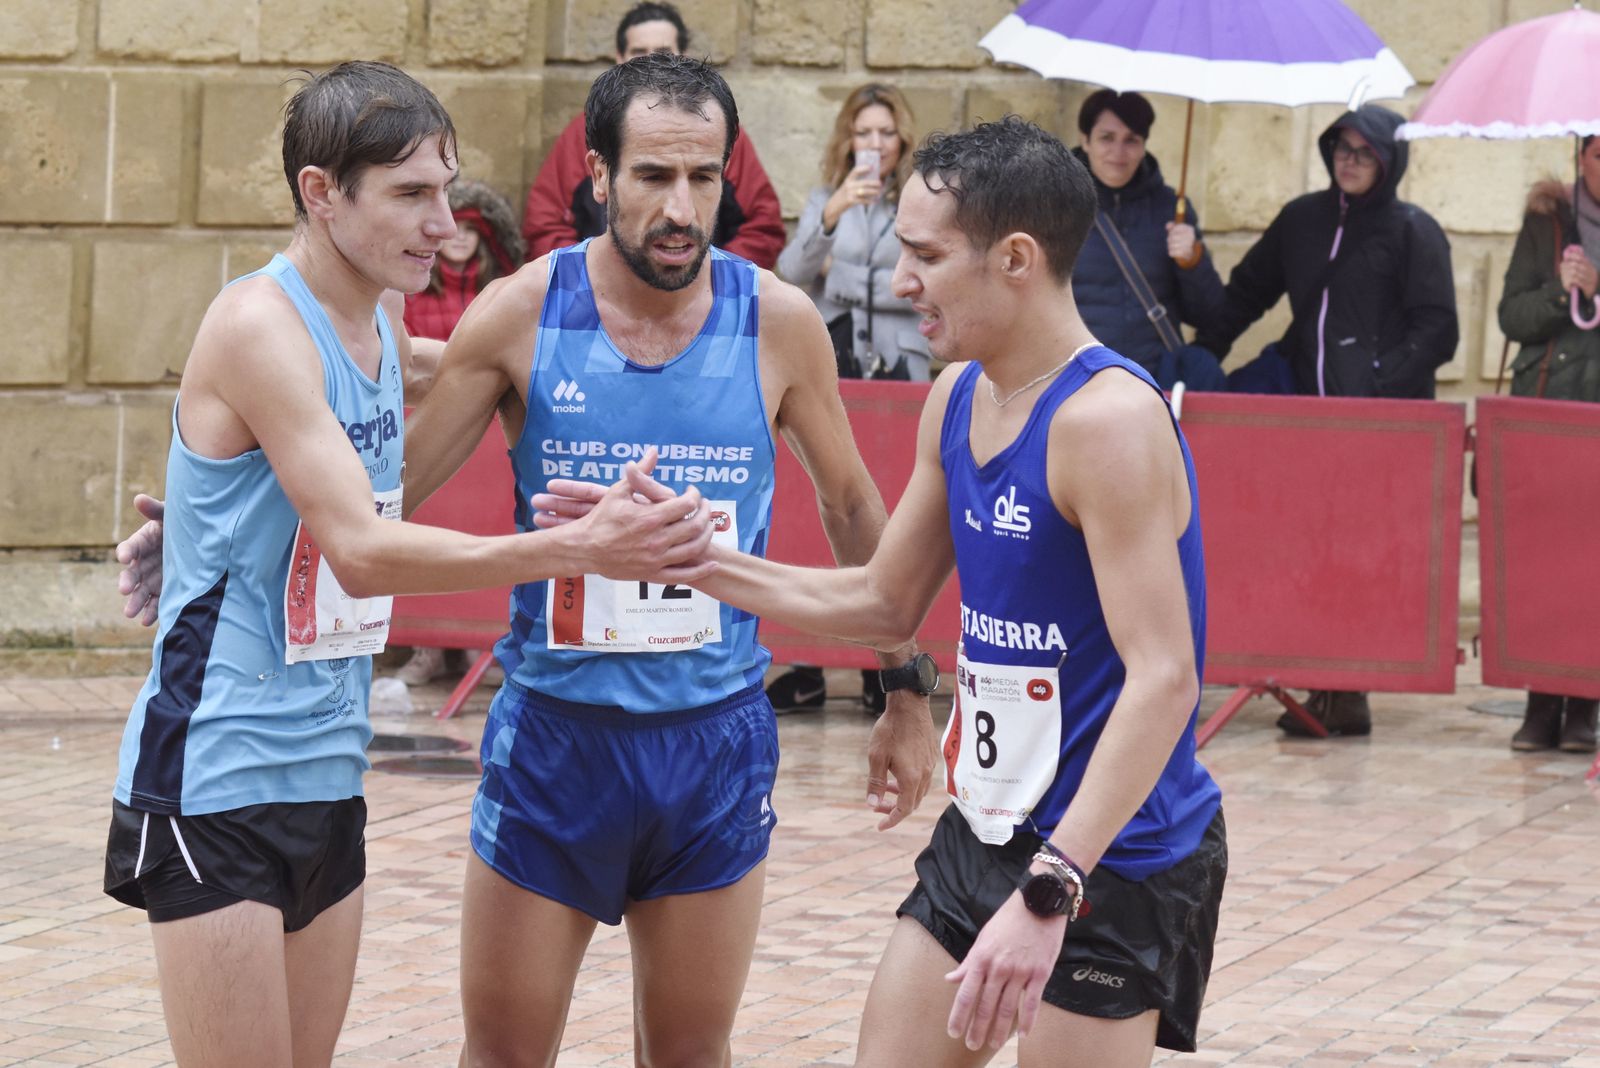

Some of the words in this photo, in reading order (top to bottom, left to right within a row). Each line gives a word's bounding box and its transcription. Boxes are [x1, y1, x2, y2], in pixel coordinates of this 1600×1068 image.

[553, 405, 585, 413] mobel
[340, 404, 398, 458] erja
[541, 439, 607, 457] CLUB
[611, 442, 754, 461] ONUBENSE
[542, 458, 575, 477] DE
[579, 461, 749, 484] ATLTISMO
[960, 601, 1068, 650] TASIERRA
[648, 635, 691, 645] Cruzcampo
[975, 710, 998, 769] 8
[1088, 970, 1126, 988] asics
